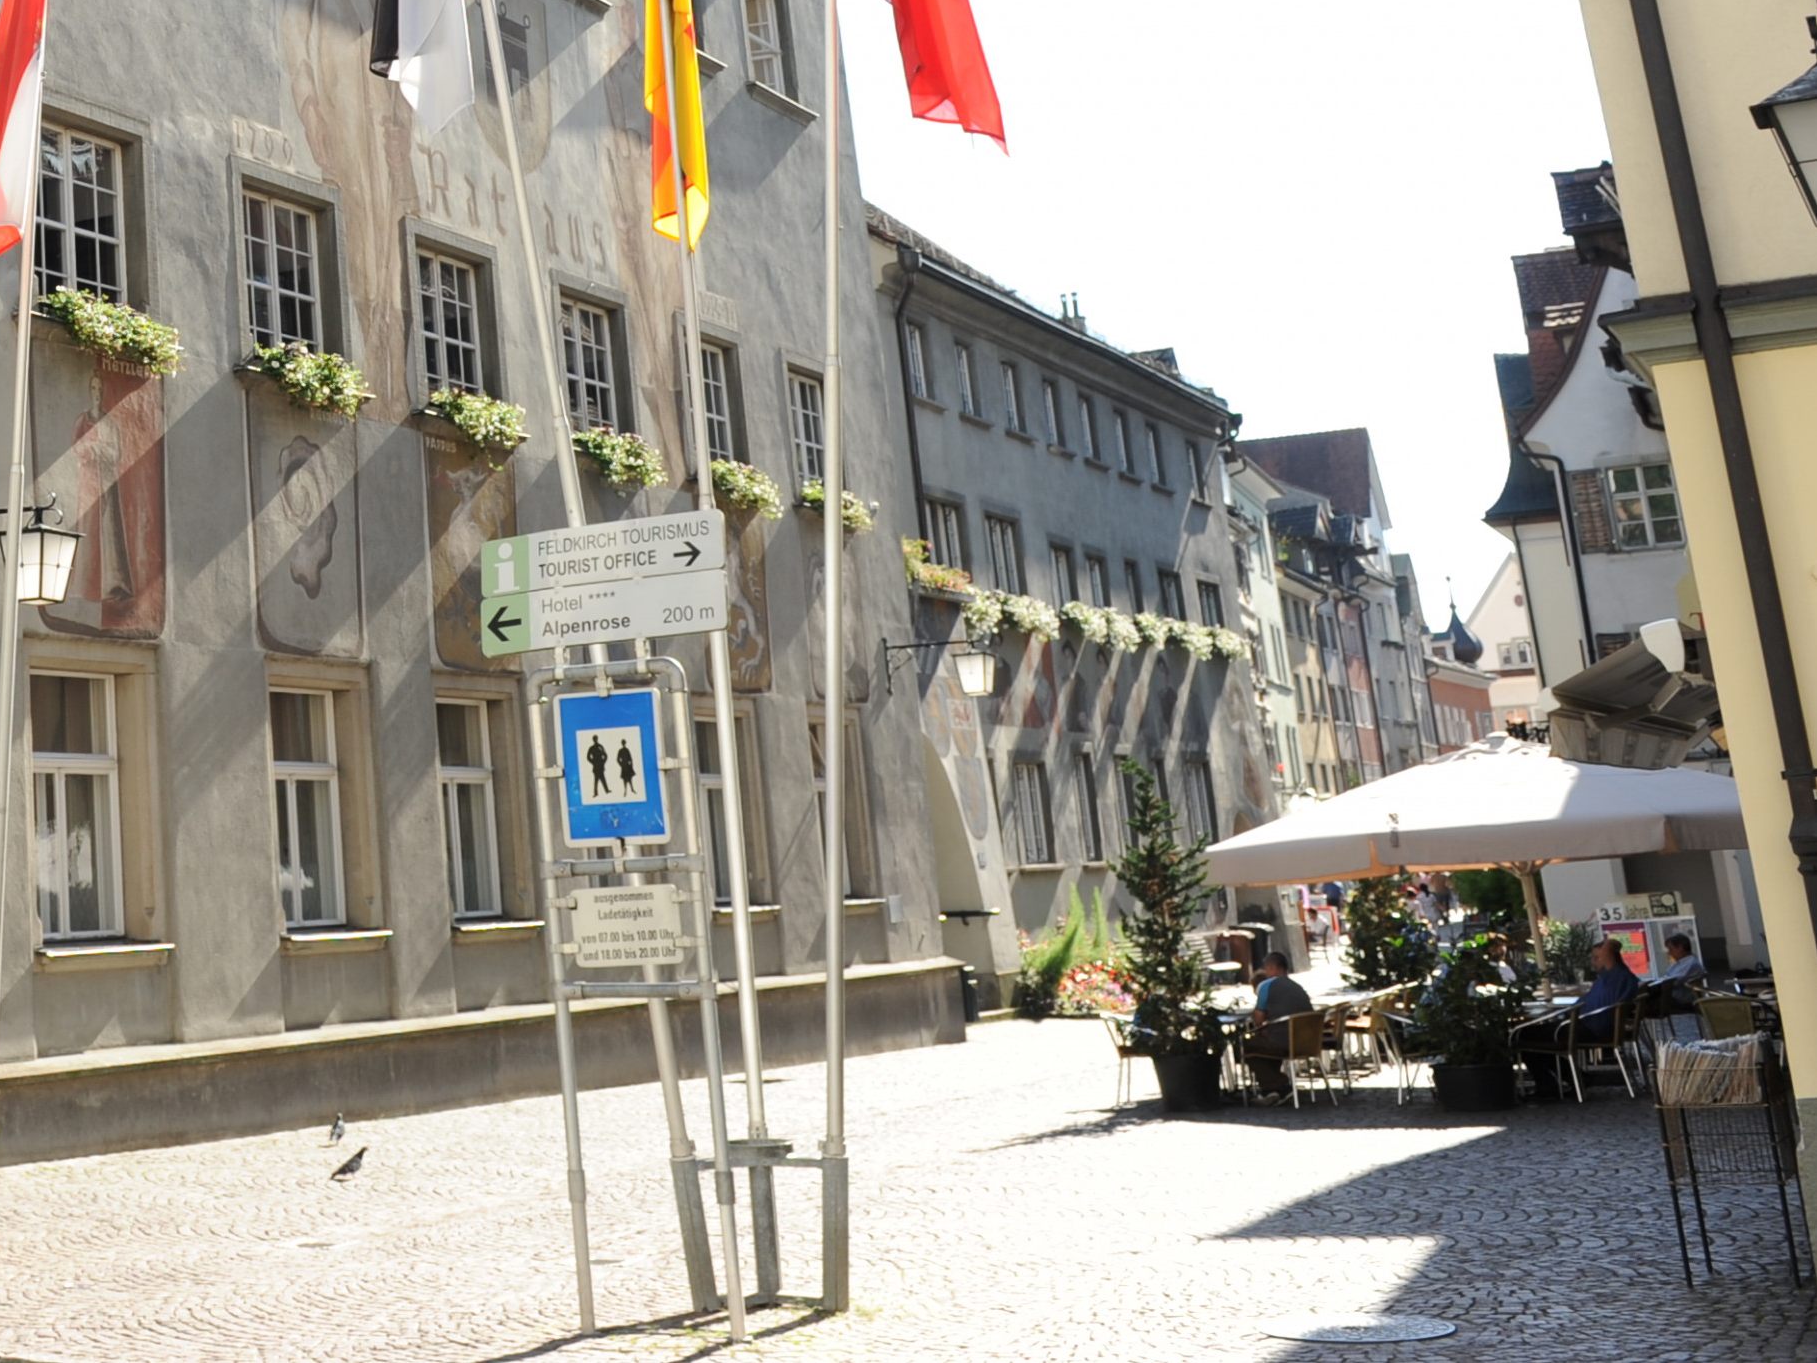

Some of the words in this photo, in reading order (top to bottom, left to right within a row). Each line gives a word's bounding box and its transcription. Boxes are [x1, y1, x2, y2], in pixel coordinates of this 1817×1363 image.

[417, 142, 608, 272] Rataus
[538, 532, 617, 557] FELDKIRCH
[621, 520, 710, 545] TOURISMUS
[539, 557, 599, 579] TOURIST
[604, 550, 657, 571] OFFICE
[541, 595, 583, 614] Hotel
[663, 605, 693, 624] 200
[699, 606, 715, 620] m
[542, 616, 631, 637] Alpenrose
[594, 892, 654, 905] ausgenommen
[597, 907, 654, 921] Ladetätigkeit
[582, 935, 597, 944] von
[599, 931, 620, 943] 07.00
[622, 931, 634, 942] bis
[637, 929, 657, 941] 10.00
[659, 928, 675, 940] Uhr
[583, 950, 599, 961] und
[624, 947, 636, 959] bis
[639, 947, 660, 958] 20.00
[661, 946, 676, 957] Uhr
